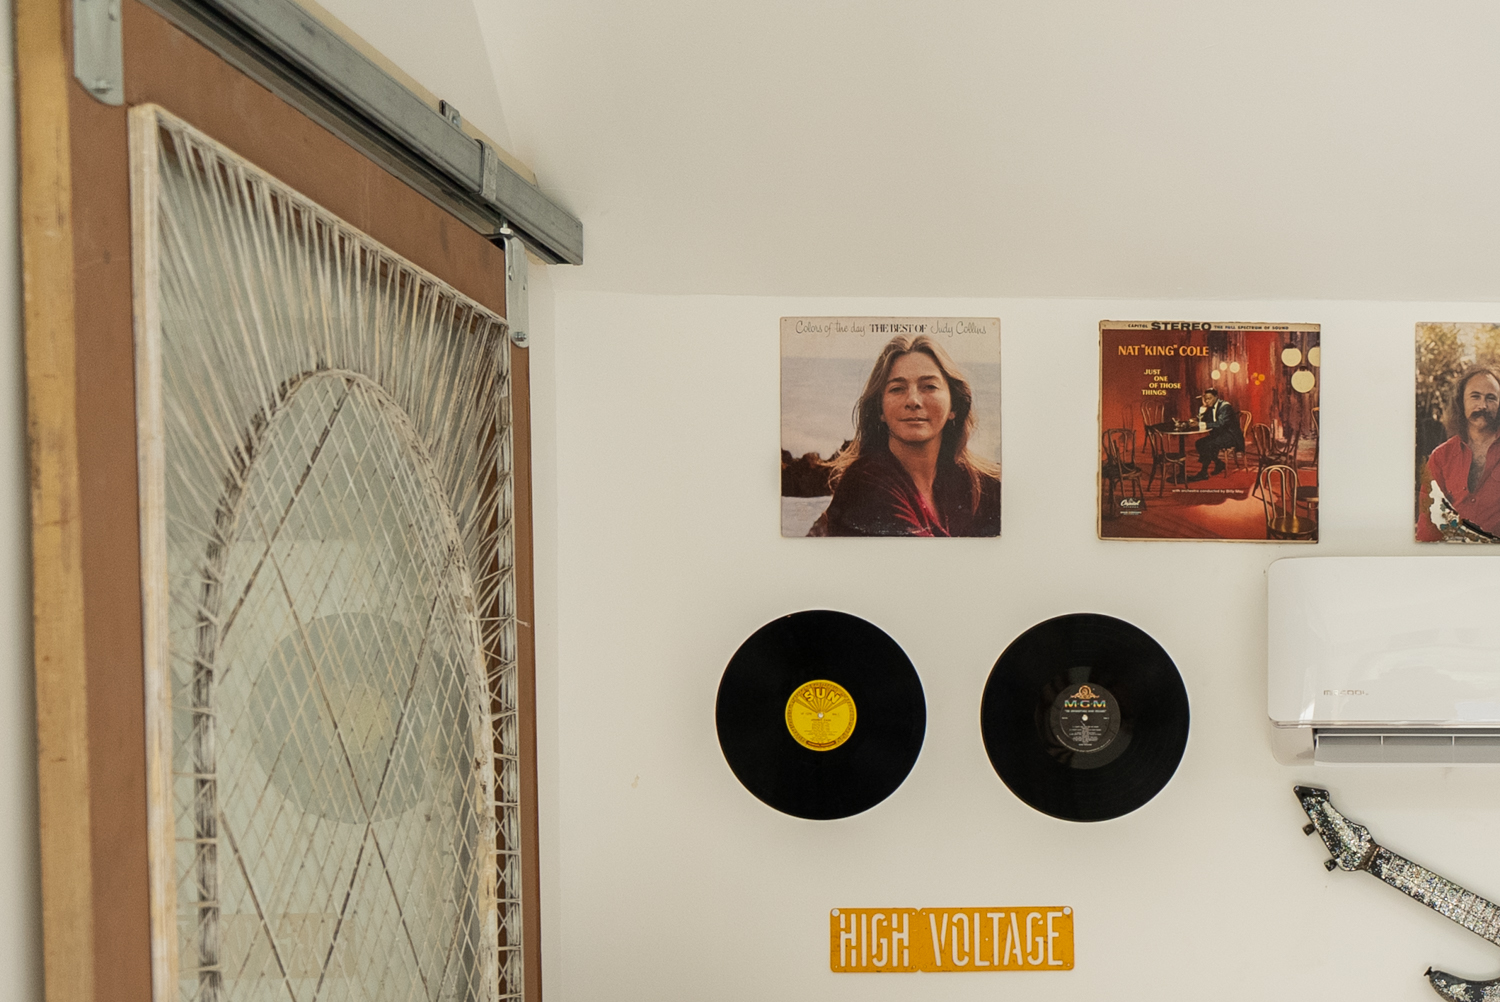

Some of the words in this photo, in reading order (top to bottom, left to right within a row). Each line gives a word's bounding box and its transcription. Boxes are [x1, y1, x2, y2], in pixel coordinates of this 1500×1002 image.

[835, 321, 849, 332] the
[851, 322, 866, 337] day
[869, 323, 889, 333] THE
[890, 323, 913, 333] BEST
[914, 323, 928, 333] OF
[930, 321, 953, 338] Judy
[955, 321, 987, 335] Collins
[1150, 321, 1212, 331] STEREO
[1118, 345, 1140, 356] NAT
[1141, 344, 1178, 356] "KING"
[1179, 345, 1209, 357] COLE
[803, 687, 840, 704] SUN
[839, 912, 909, 968] HIGH
[928, 911, 1064, 967] VOLTAGE
